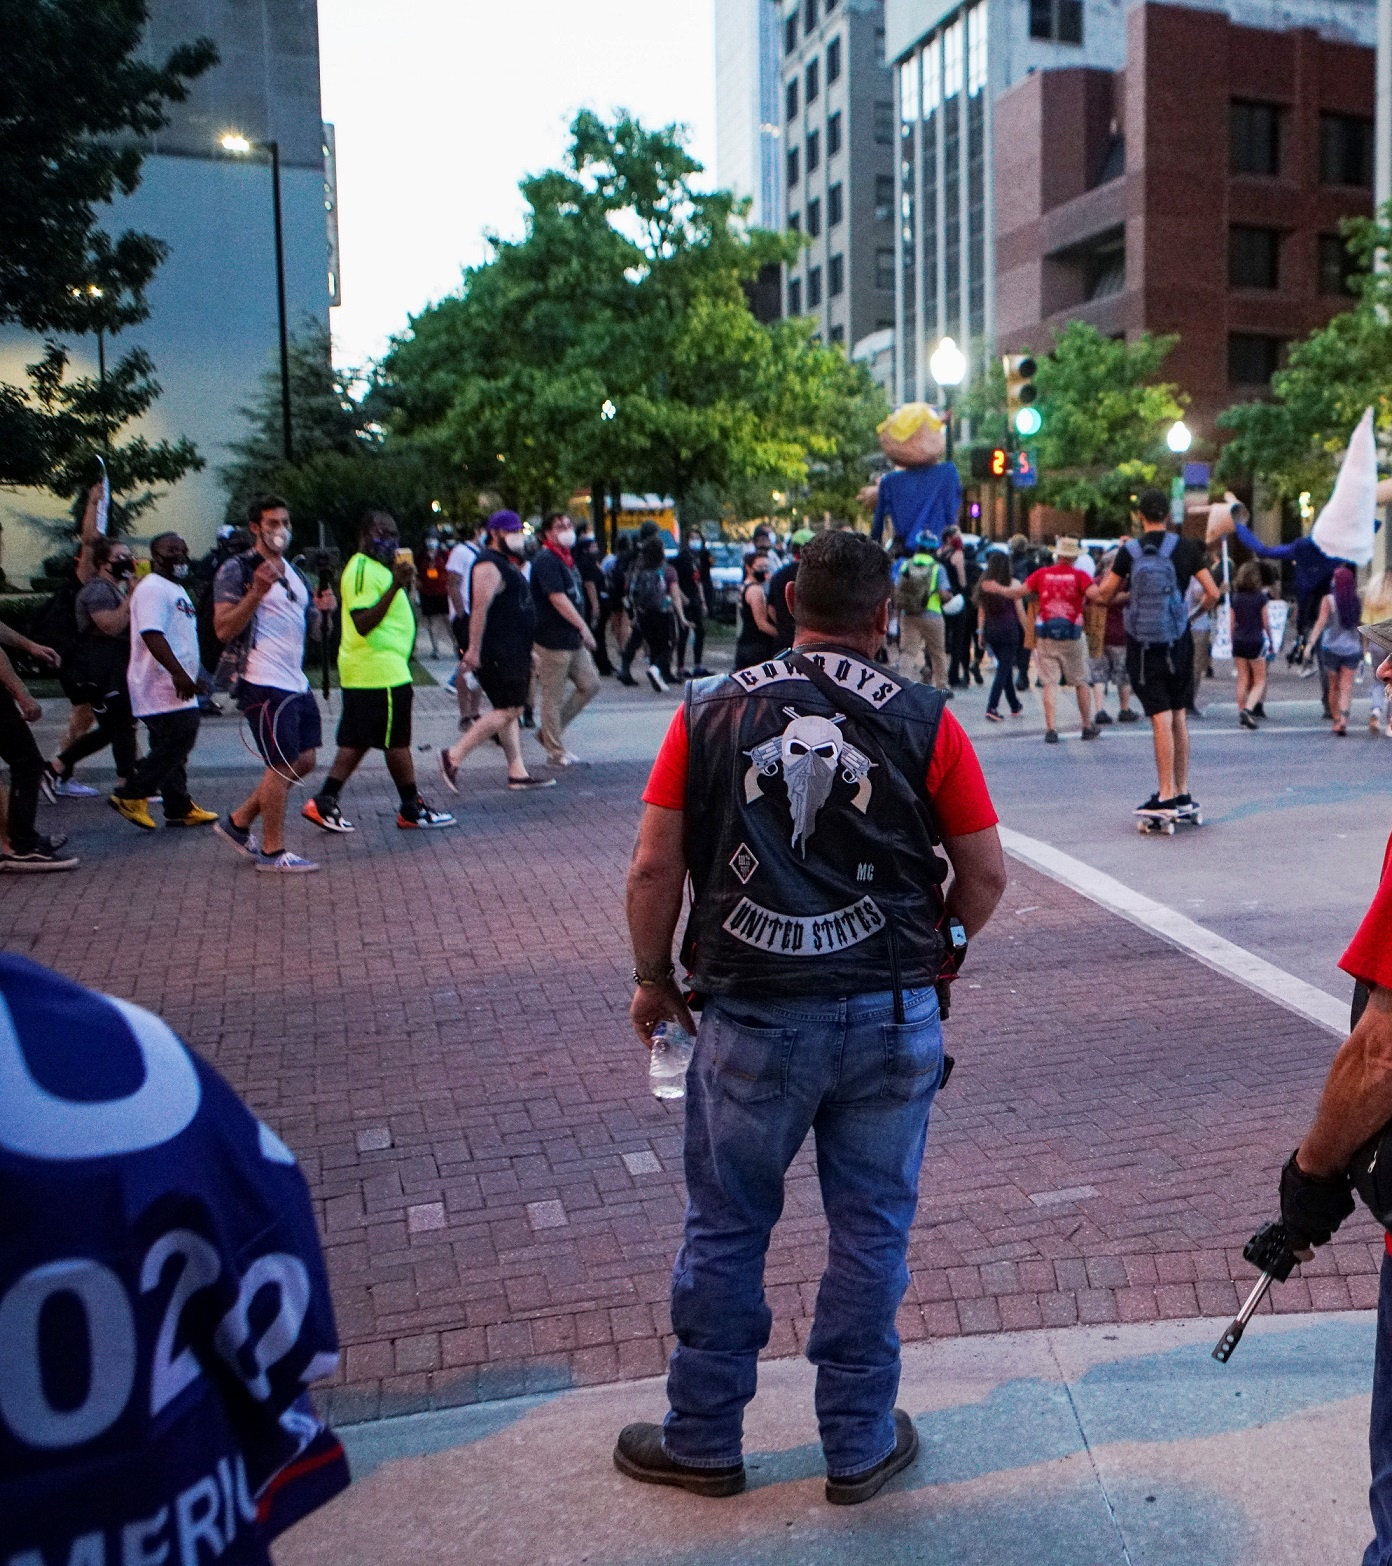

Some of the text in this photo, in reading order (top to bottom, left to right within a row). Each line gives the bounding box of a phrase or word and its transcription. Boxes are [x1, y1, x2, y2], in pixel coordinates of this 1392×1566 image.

[857, 862, 874, 882] MC
[730, 900, 882, 952] UNITED STATES
